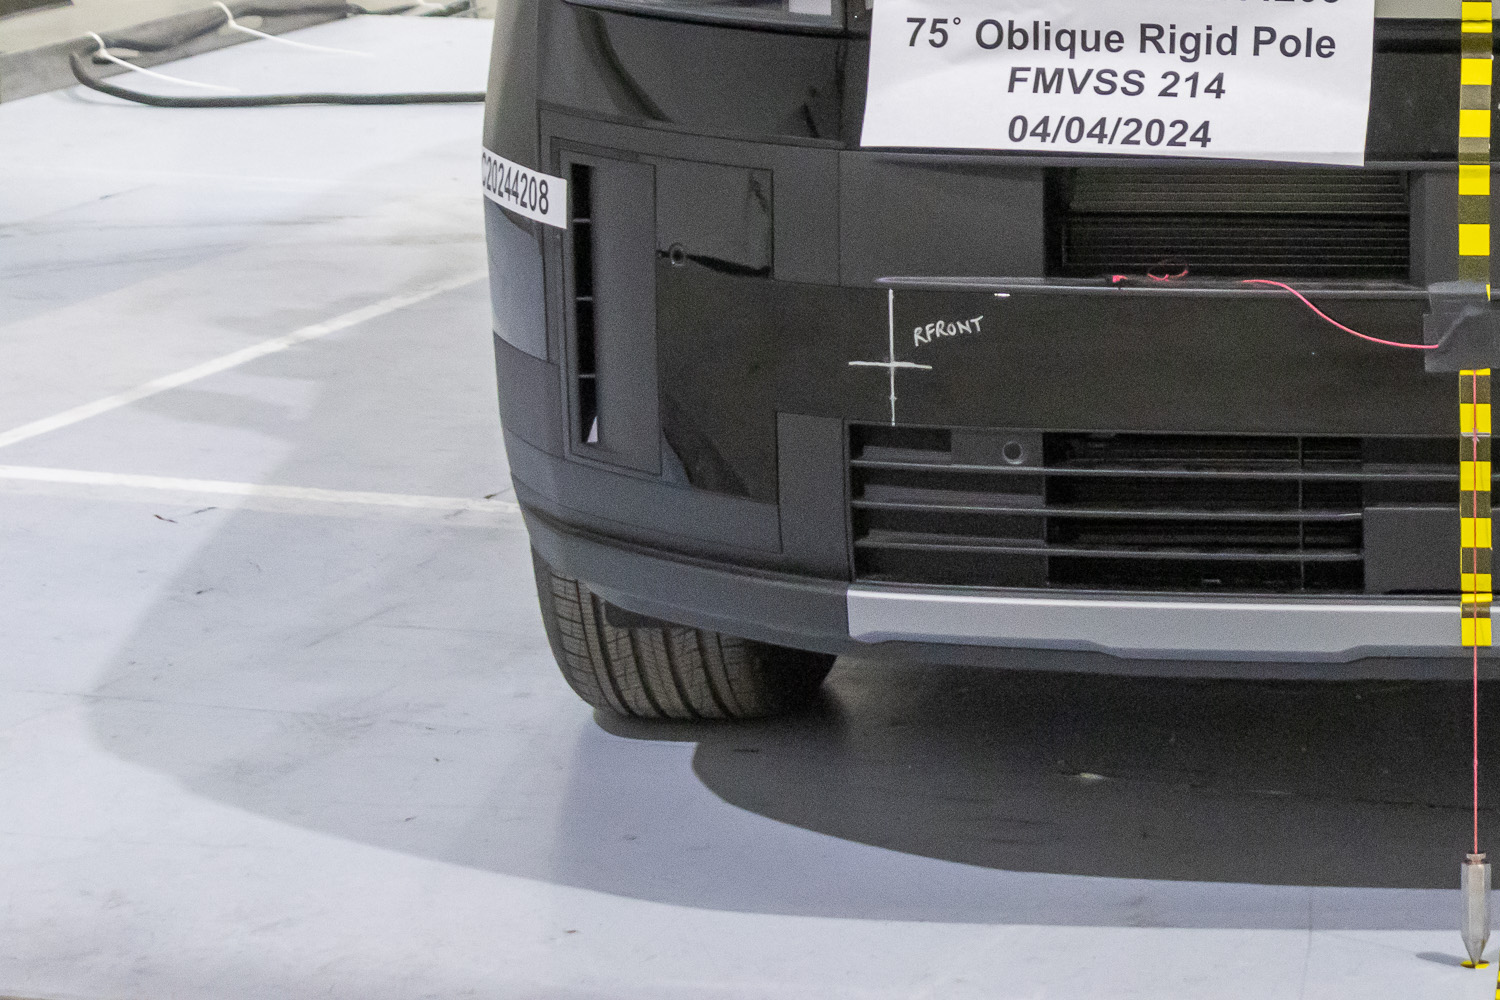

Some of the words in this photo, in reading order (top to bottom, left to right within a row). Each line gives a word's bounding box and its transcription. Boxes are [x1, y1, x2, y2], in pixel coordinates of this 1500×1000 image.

[975, 18, 1125, 59] Oblique
[1139, 23, 1238, 63] Rigid
[1252, 26, 1336, 58] Pole
[1007, 66, 1146, 97] FMVSS
[1157, 71, 1226, 99] 214
[1008, 114, 1212, 148] 04/04/2024
[914, 315, 984, 347] RFRONT
